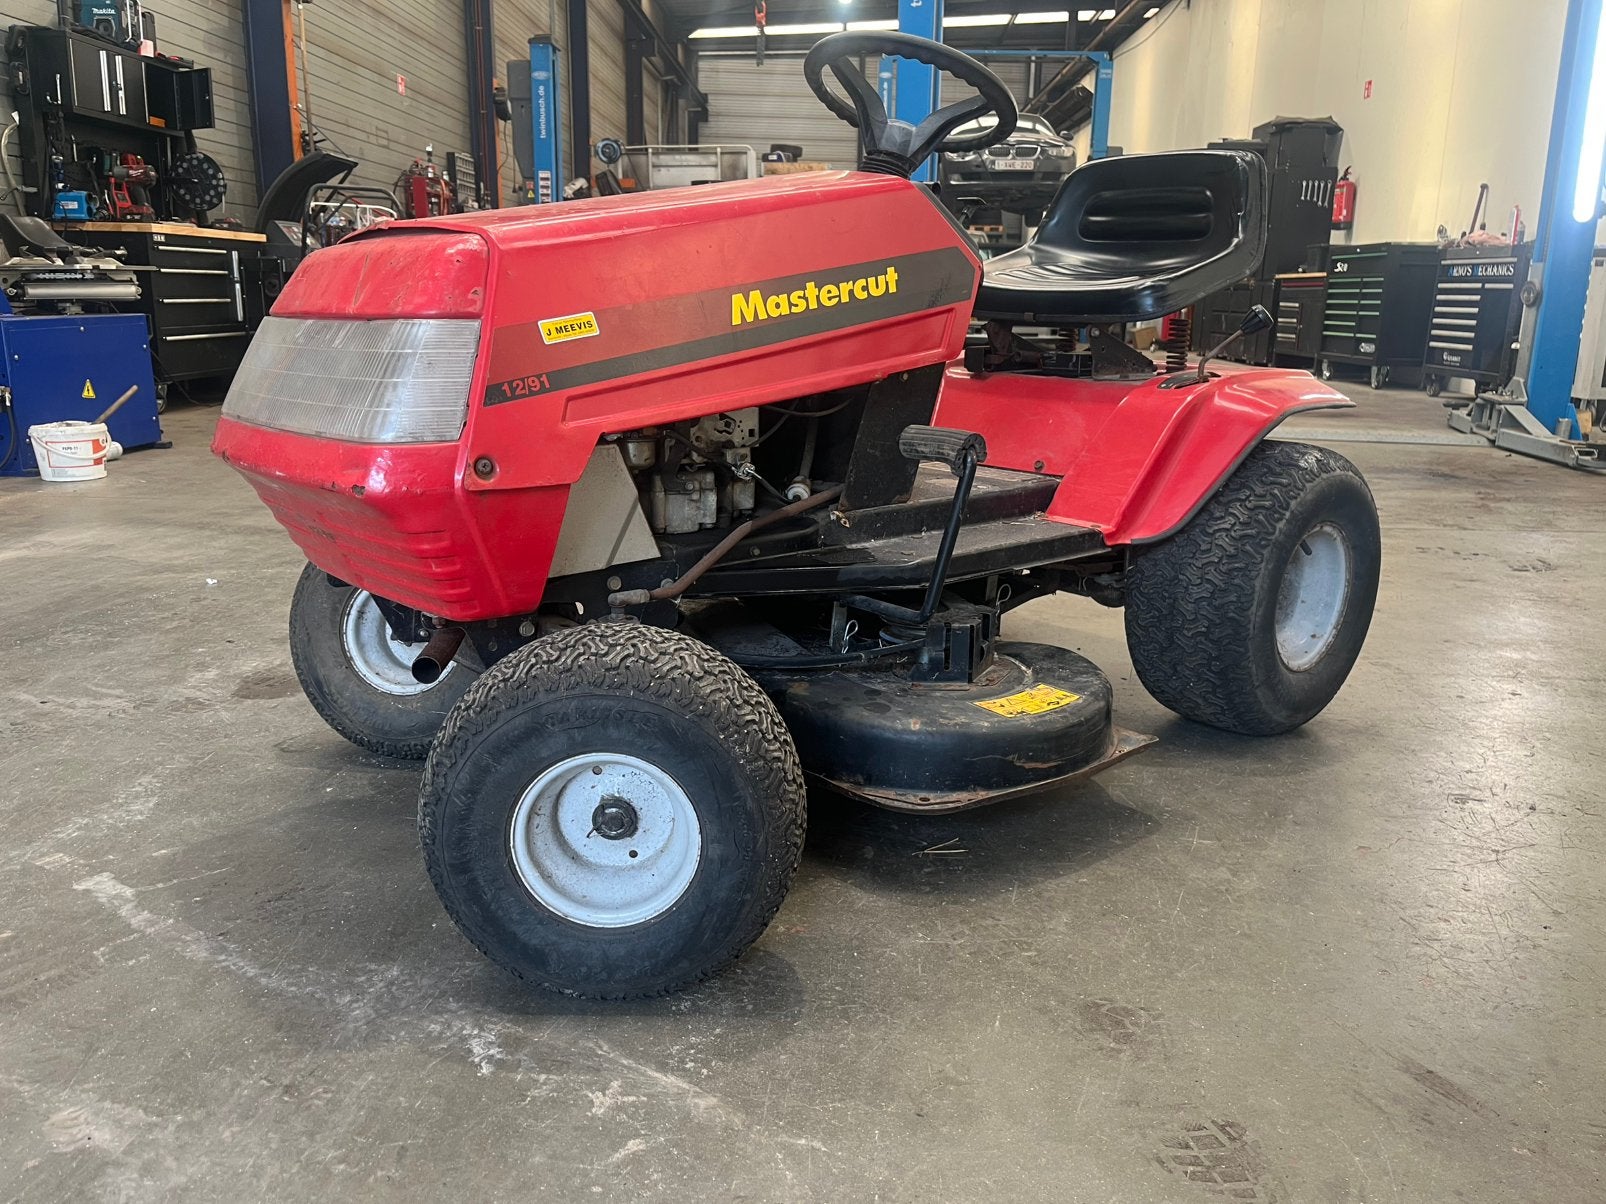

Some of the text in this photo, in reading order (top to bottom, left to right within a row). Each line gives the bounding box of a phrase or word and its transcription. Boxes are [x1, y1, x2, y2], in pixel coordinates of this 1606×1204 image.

[537, 85, 547, 139] twinbusch.de
[1473, 263, 1514, 276] MECHANICS
[731, 266, 898, 326] Mastercut
[546, 328, 552, 337] J
[555, 320, 593, 335] MEEVIS
[501, 373, 550, 397] 12/91
